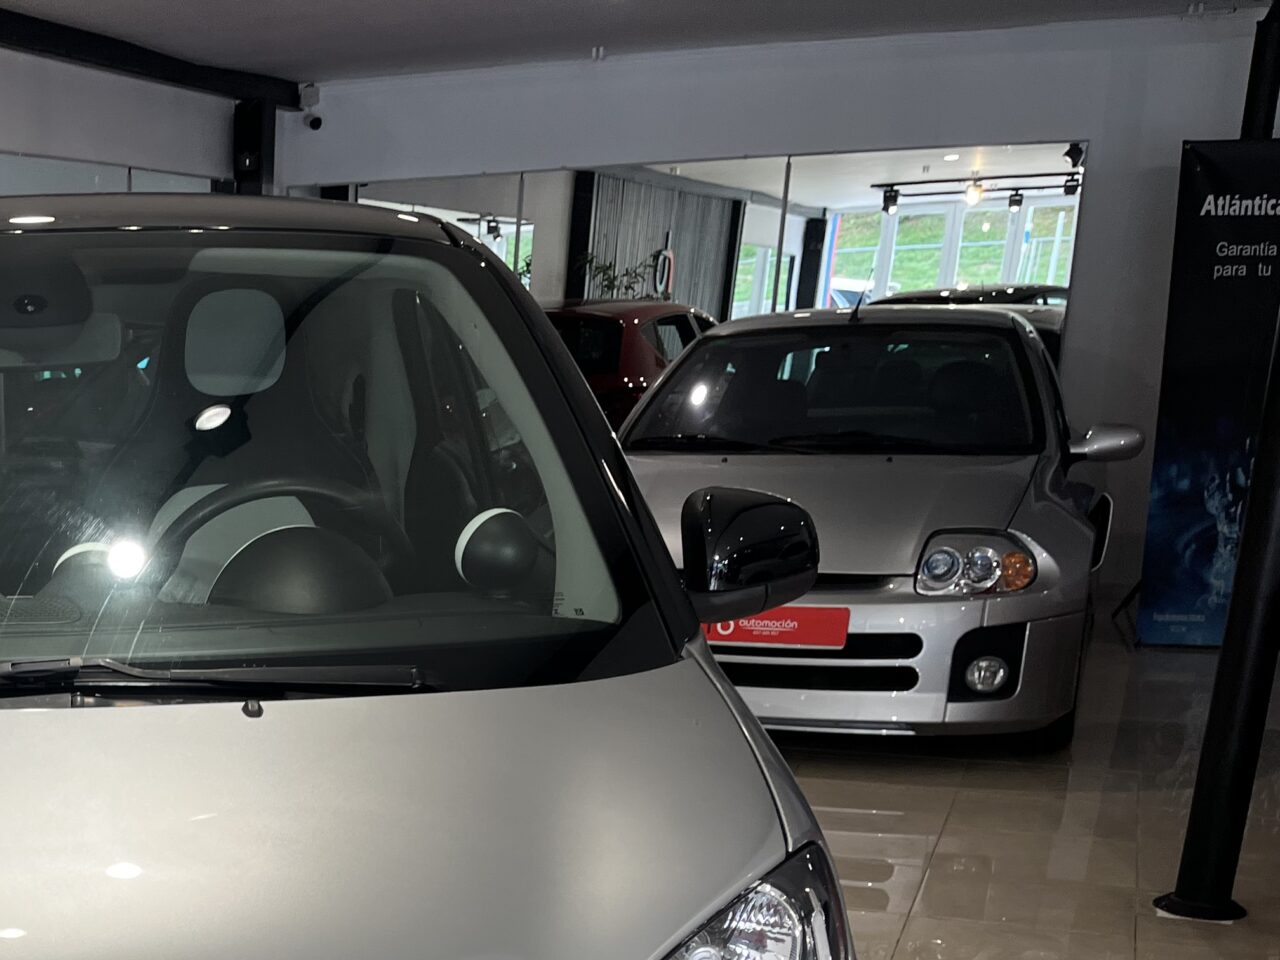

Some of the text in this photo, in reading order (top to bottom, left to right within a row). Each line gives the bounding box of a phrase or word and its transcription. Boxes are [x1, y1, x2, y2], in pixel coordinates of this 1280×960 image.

[1215, 241, 1278, 257] Garantía
[1213, 262, 1272, 281] para tu
[739, 618, 798, 630] automoción
